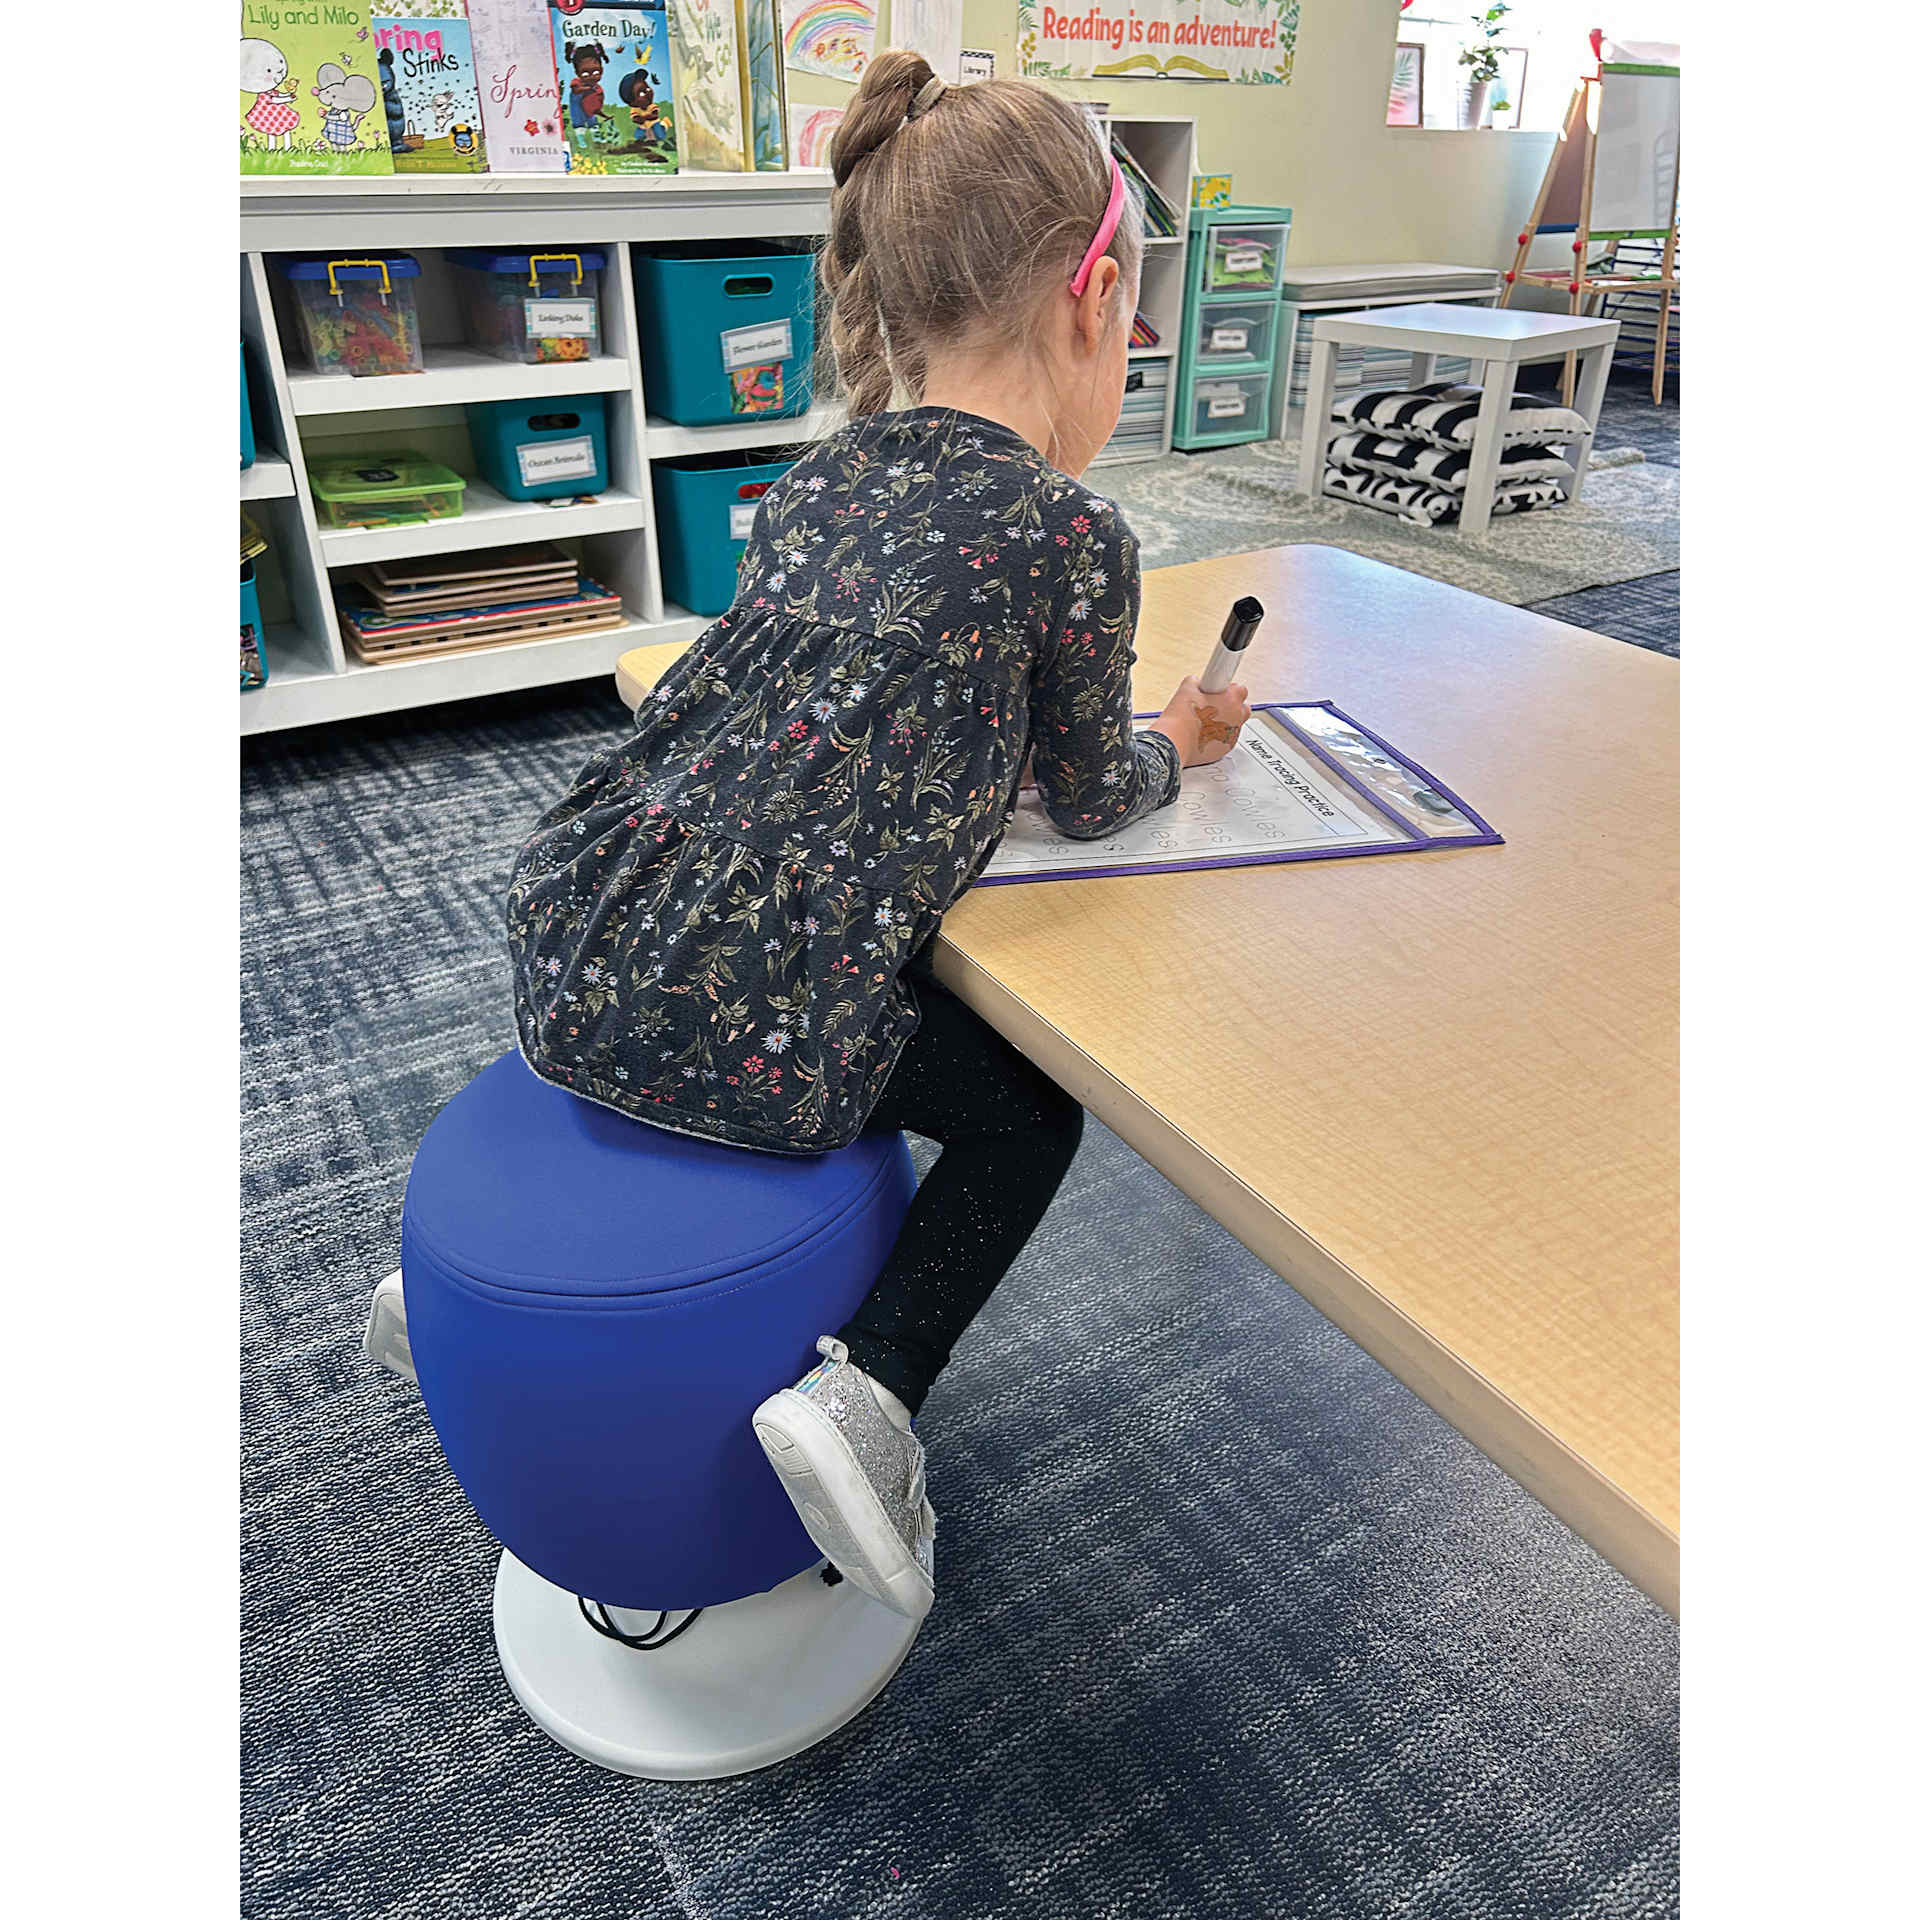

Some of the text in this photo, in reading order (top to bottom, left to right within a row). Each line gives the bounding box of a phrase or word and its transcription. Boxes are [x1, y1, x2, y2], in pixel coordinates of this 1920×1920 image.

[247, 4, 359, 30] Lily and Milo
[562, 19, 657, 44] Garden Day!
[1042, 6, 1278, 50] Reading is an adventure!
[402, 47, 459, 77] Stinks
[490, 65, 559, 119] Sprin
[1245, 739, 1335, 817] Name Tracing Practice
